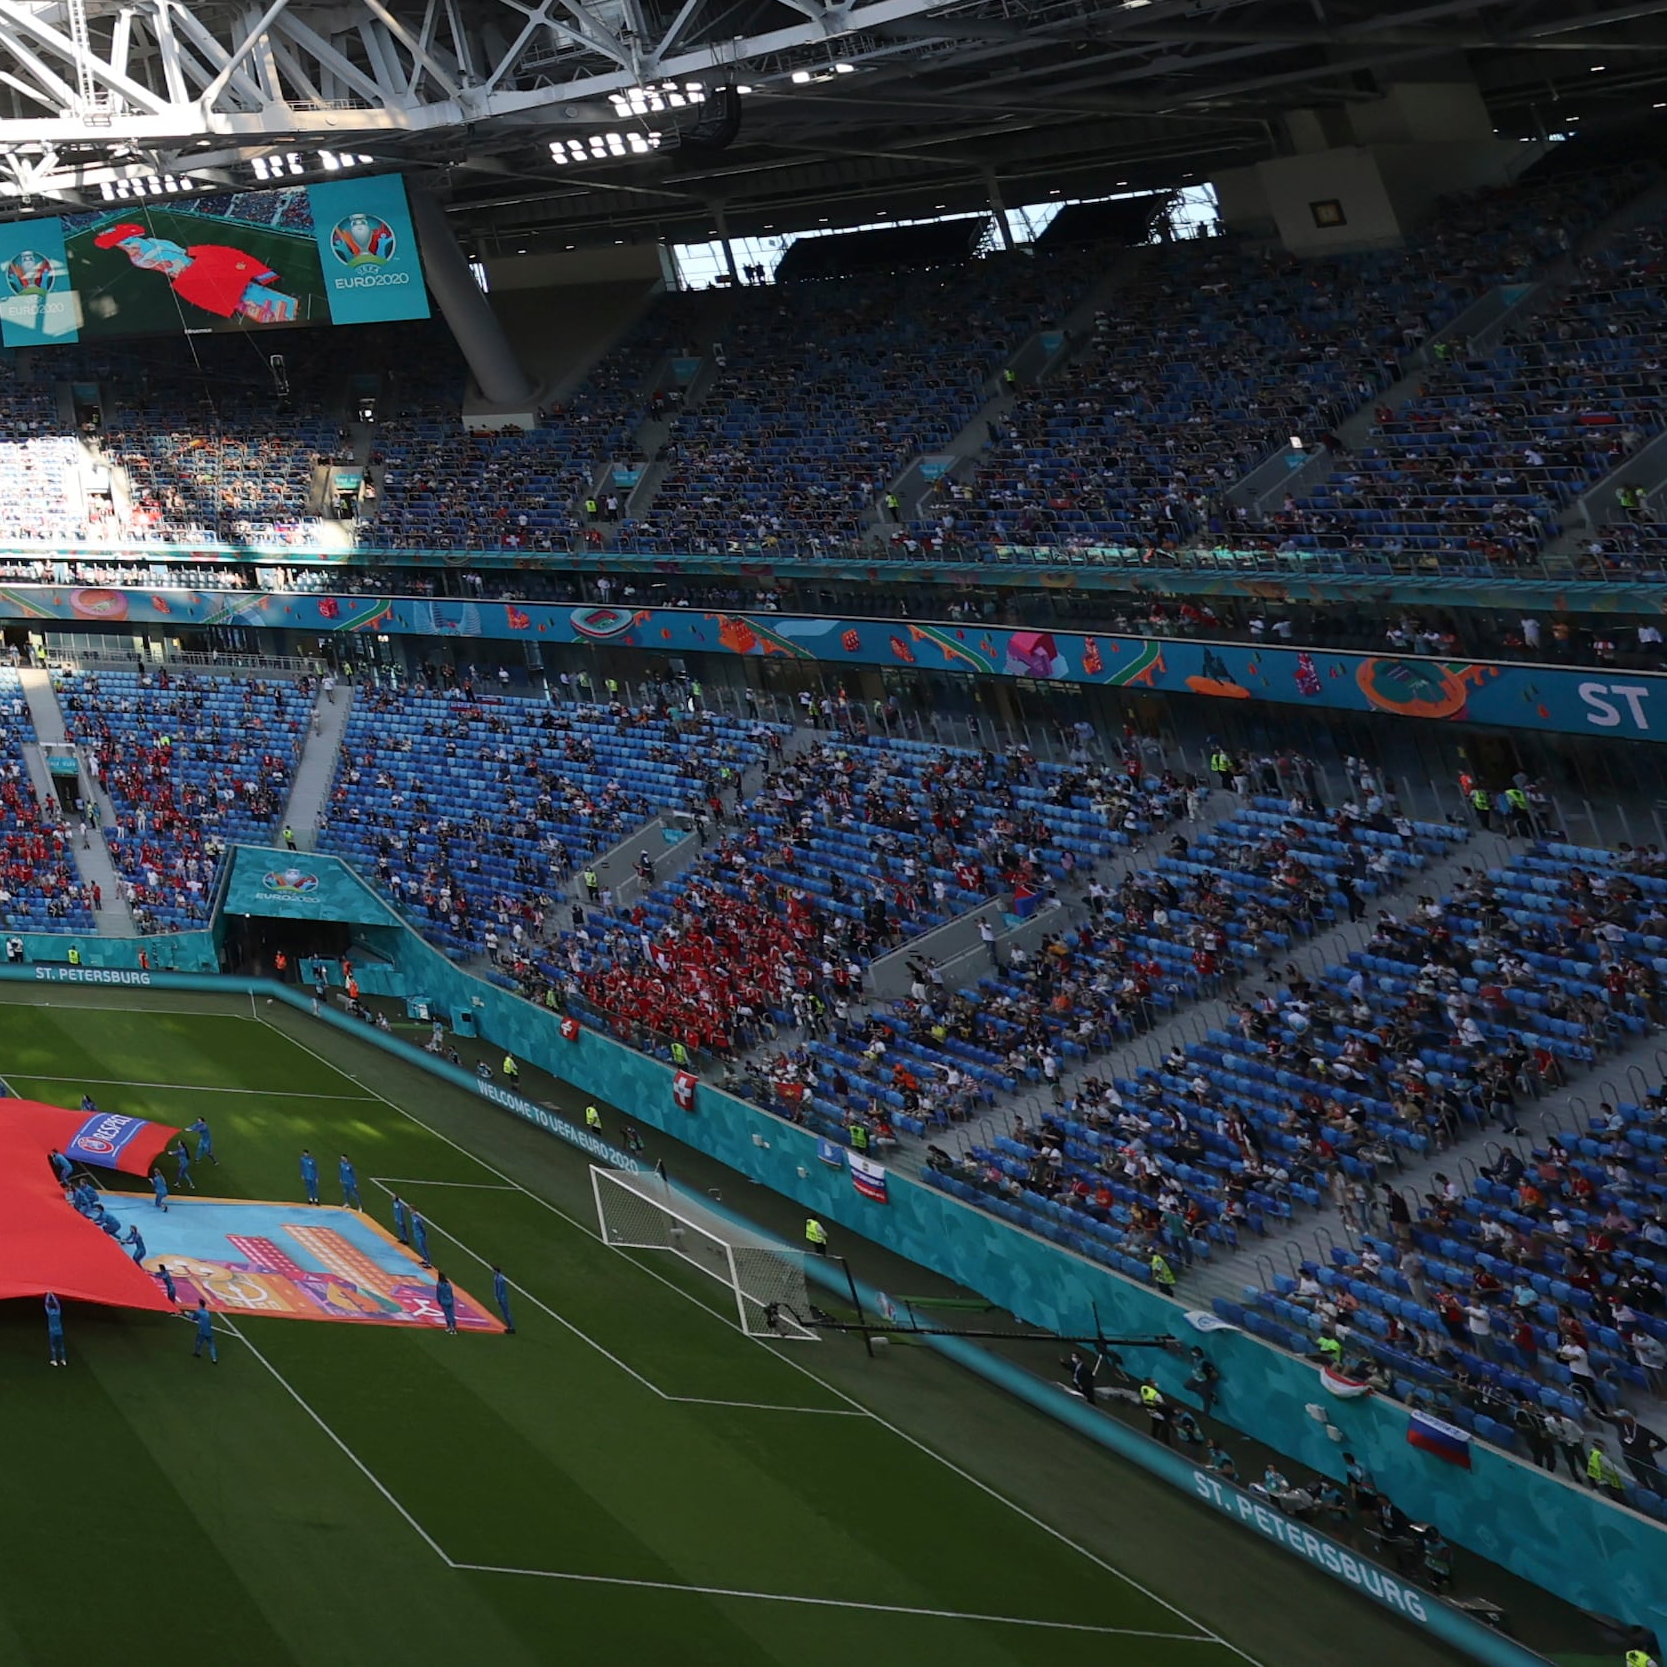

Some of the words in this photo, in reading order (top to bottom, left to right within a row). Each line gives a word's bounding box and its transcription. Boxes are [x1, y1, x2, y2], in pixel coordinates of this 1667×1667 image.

[334, 272, 410, 290] EURO2020
[1578, 682, 1650, 730] ST
[255, 892, 321, 904] EURO2020
[35, 967, 55, 980] ST.
[59, 968, 151, 985] PETERSBURG
[477, 1079, 533, 1118] WELCOME
[532, 1106, 549, 1126] TO
[549, 1114, 579, 1144] UEFA
[578, 1132, 609, 1160] EURO
[608, 1148, 640, 1176] 2020
[1192, 1471, 1232, 1511] ST.
[1236, 1494, 1428, 1623] PETERSBURG
